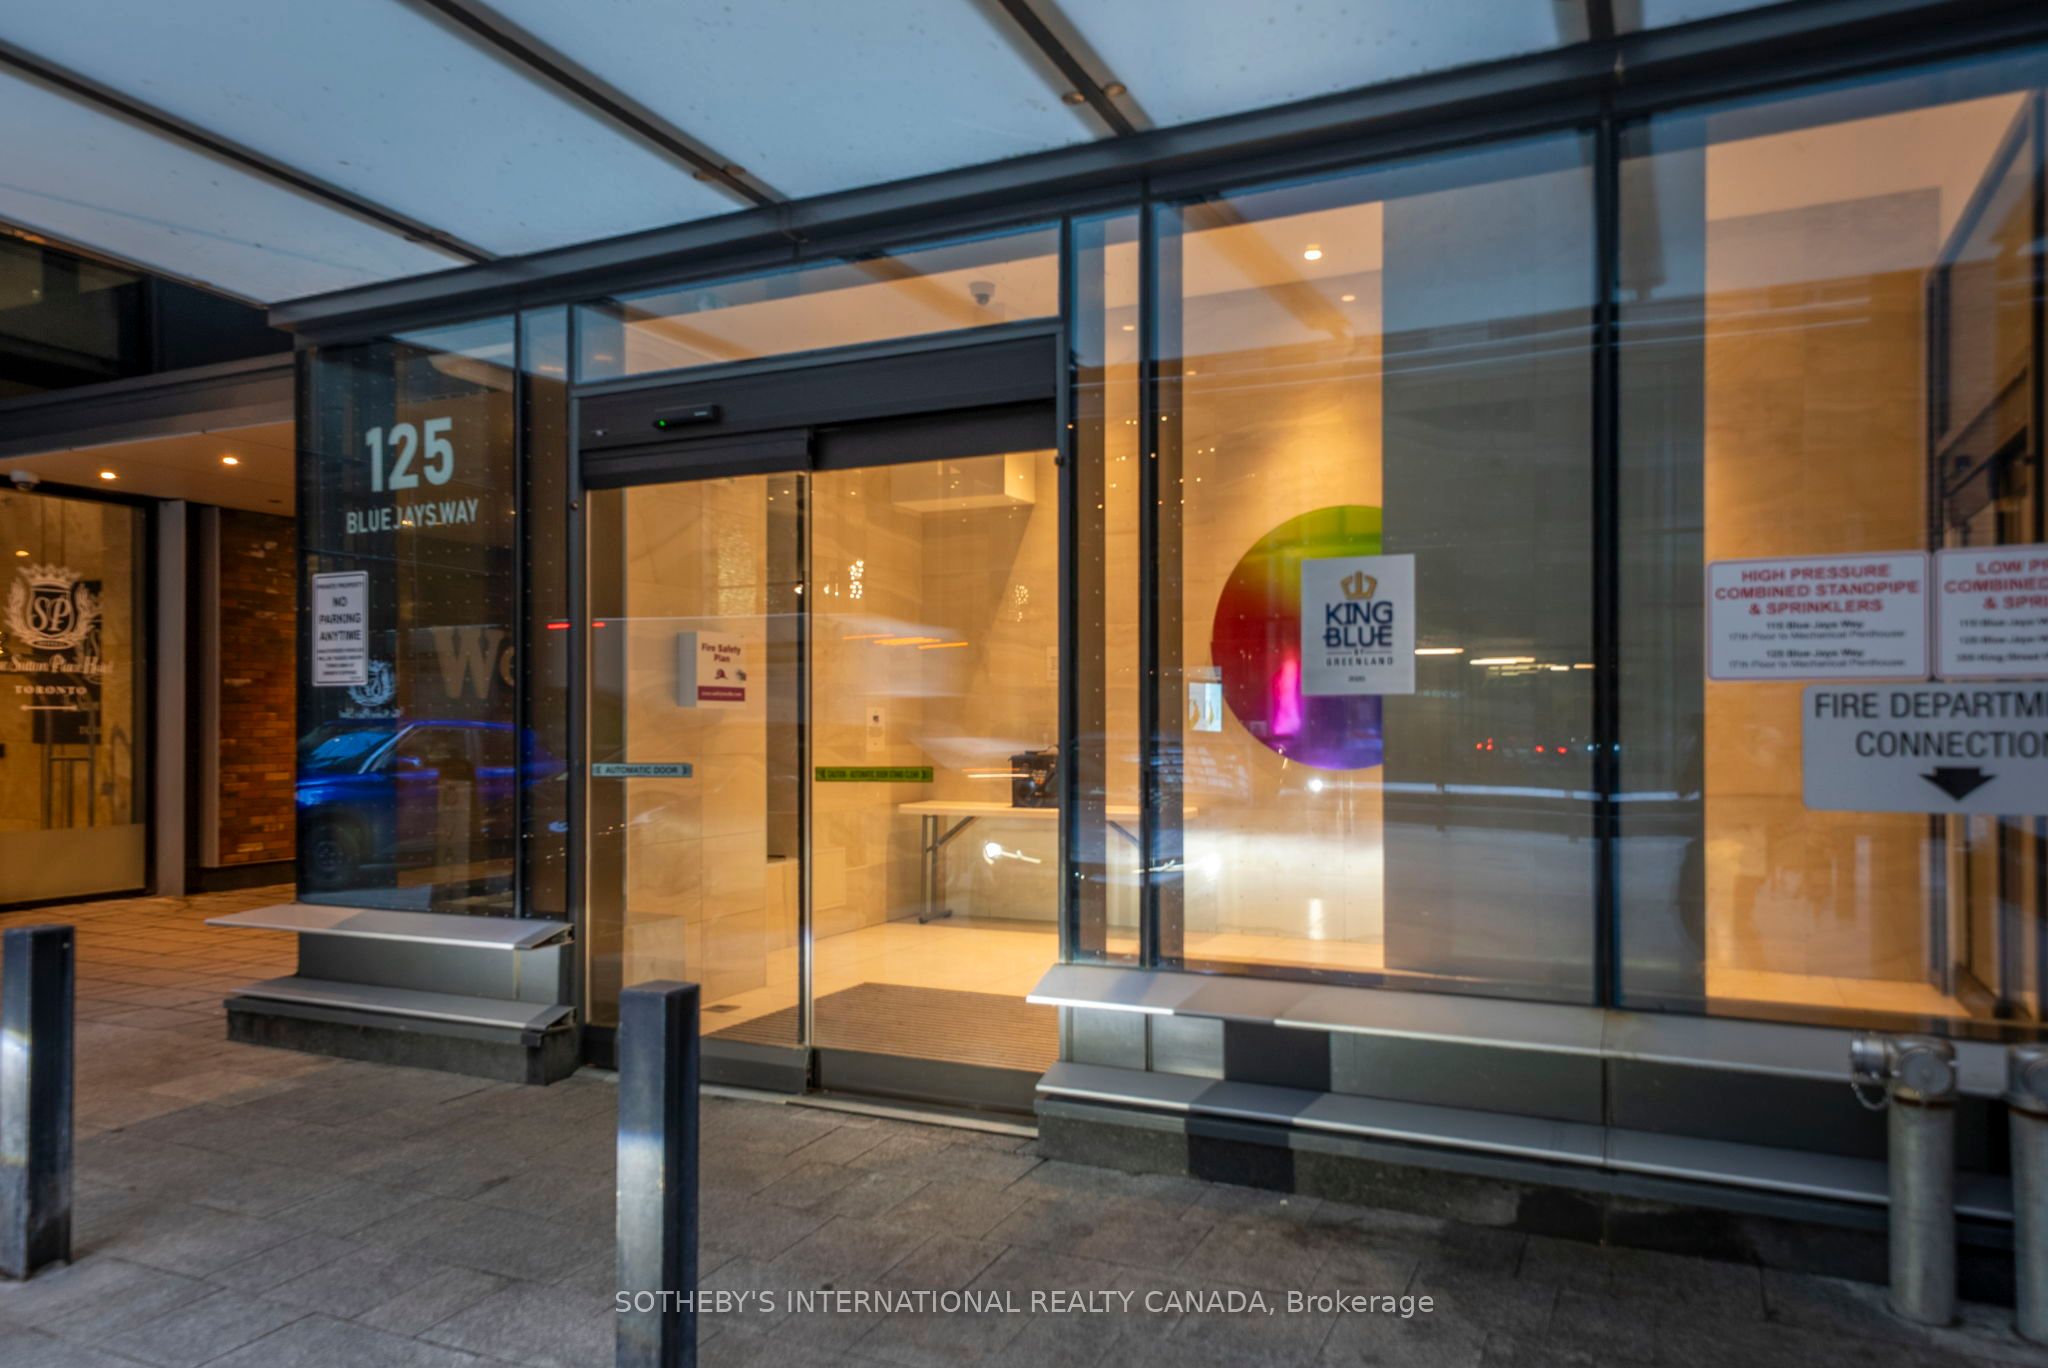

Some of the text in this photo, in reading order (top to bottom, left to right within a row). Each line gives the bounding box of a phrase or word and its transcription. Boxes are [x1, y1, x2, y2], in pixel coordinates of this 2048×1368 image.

[366, 417, 455, 492] 125
[347, 498, 479, 534] BLUE JAYS WAY
[1742, 564, 1891, 582] HIGH PRESSURE
[1976, 561, 2022, 575] LOW
[1715, 580, 1920, 600] COMBINED STANDPIPE
[332, 596, 348, 607] NO
[1749, 598, 1884, 615] & SPRINKLERS
[1983, 596, 1997, 610] &
[320, 613, 361, 624] PARKING
[1325, 601, 1393, 625] KING
[320, 630, 361, 640] ANYTIME
[1323, 625, 1392, 648] BLUE
[701, 643, 741, 656] Fire Safety
[714, 653, 730, 662] Plan
[1326, 656, 1393, 667] GREENLAND
[15, 685, 87, 695] TORONTO
[1814, 691, 2048, 718] FIRE DEPARTM
[605, 766, 678, 774] AUTOMATIC DOOR
